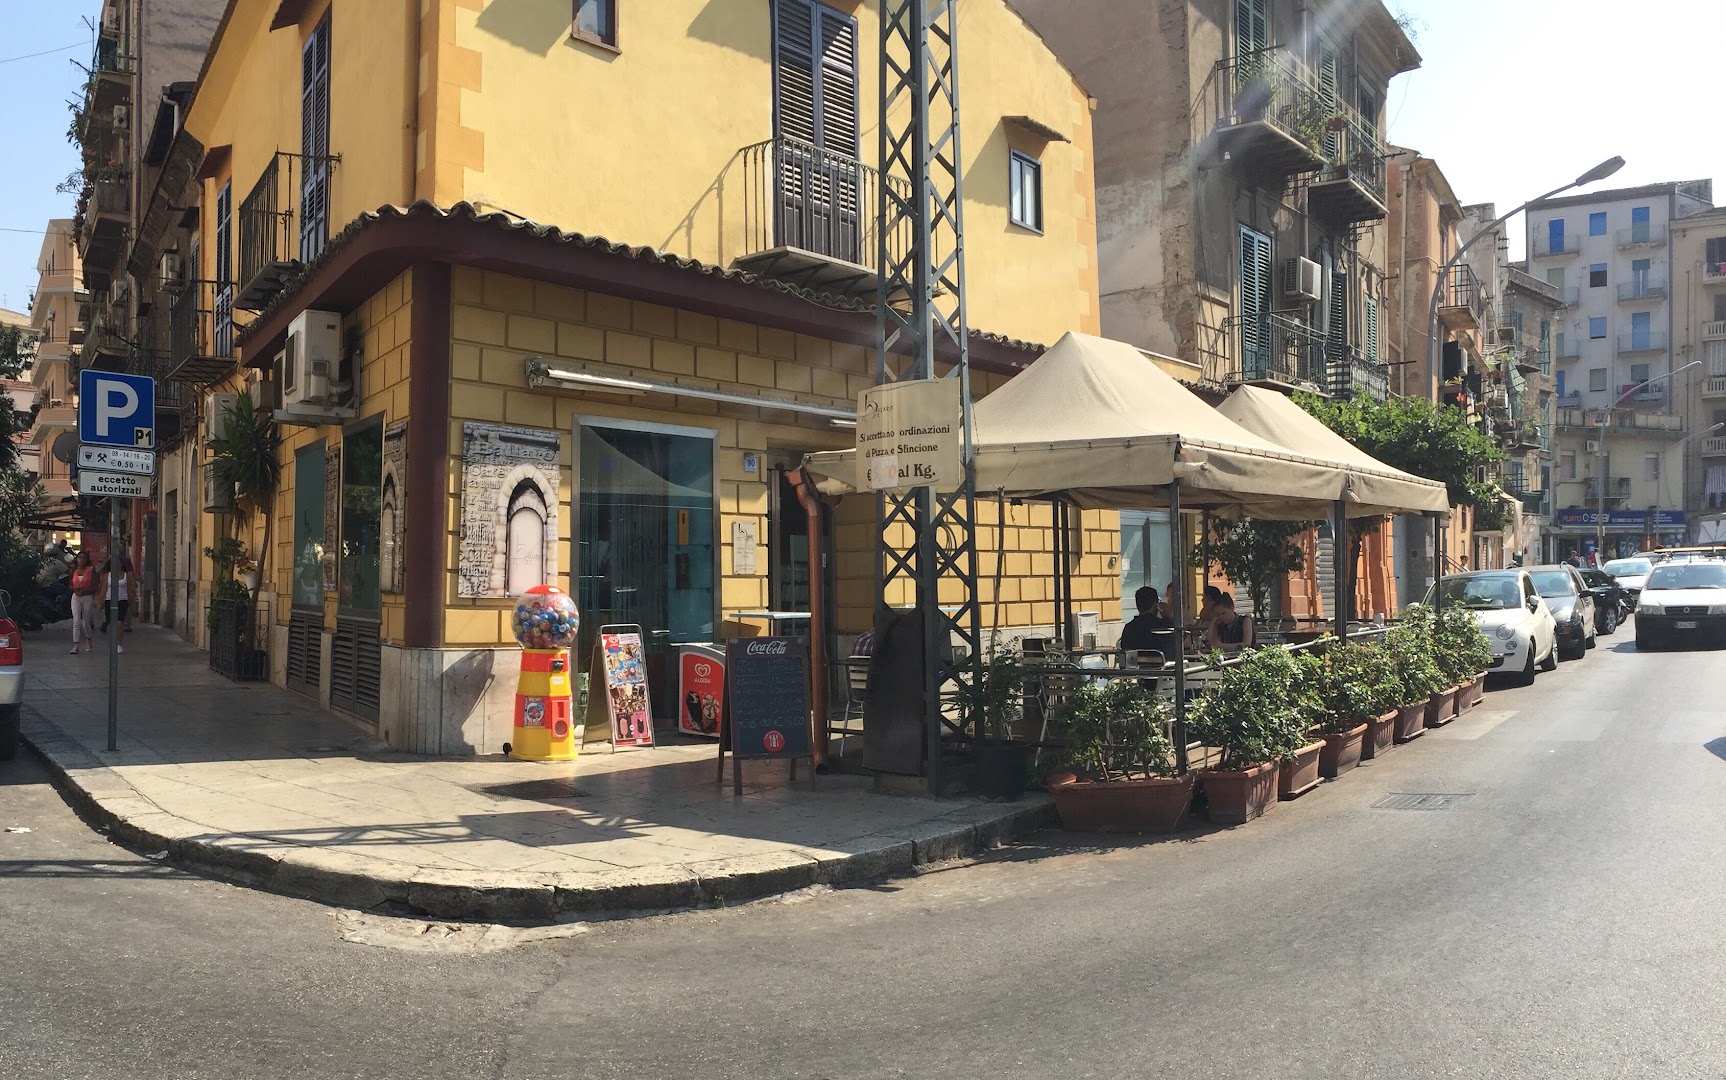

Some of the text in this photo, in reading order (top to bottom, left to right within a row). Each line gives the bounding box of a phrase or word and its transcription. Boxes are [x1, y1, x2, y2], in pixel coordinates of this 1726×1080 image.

[96, 379, 139, 436] P
[135, 429, 152, 446] P1
[866, 429, 895, 441] accettano
[899, 424, 950, 437] ordinazioni
[871, 447, 889, 458] Pizza
[897, 443, 939, 455] Sfincione
[898, 464, 910, 478] al
[913, 463, 936, 480] Kg.
[98, 476, 136, 485] eccetto
[90, 485, 142, 495] autorizzati
[746, 640, 788, 655] Coca-Cola
